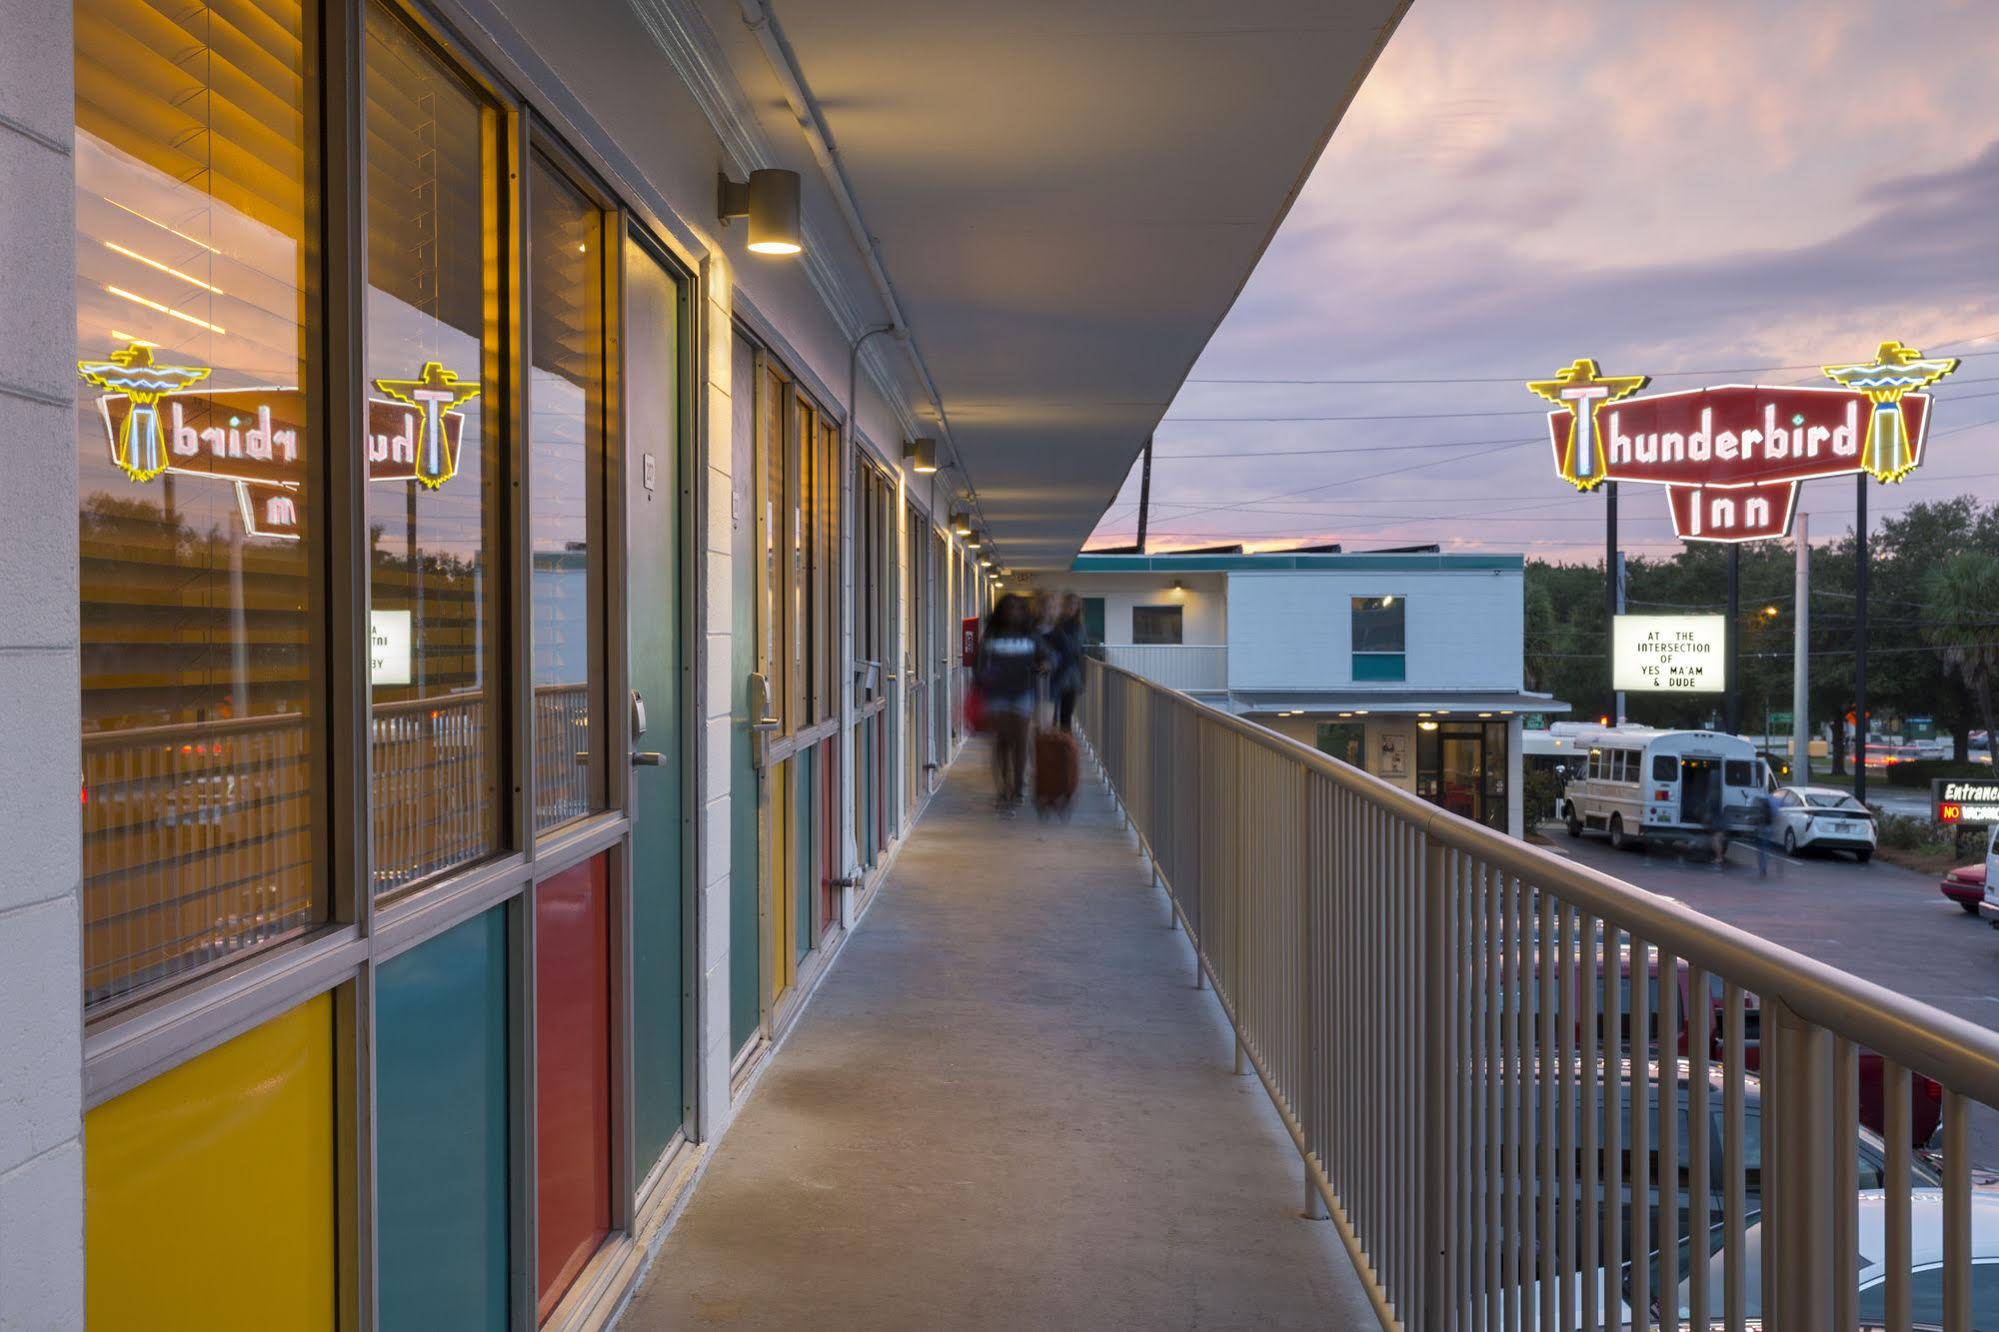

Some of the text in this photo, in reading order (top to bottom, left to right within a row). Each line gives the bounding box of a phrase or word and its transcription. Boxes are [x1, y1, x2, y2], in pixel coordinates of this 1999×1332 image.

[1560, 385, 1858, 477] Thunderbird
[1690, 489, 1770, 537] Inn
[1648, 632, 1694, 641] AT THE
[1638, 643, 1710, 652] INTERSECTION
[1660, 655, 1673, 664] OF
[1641, 666, 1703, 675] YES MA'AM
[1654, 678, 1695, 687] & DUDE
[1945, 784, 1999, 800] Entranc
[1944, 806, 1960, 819] NO
